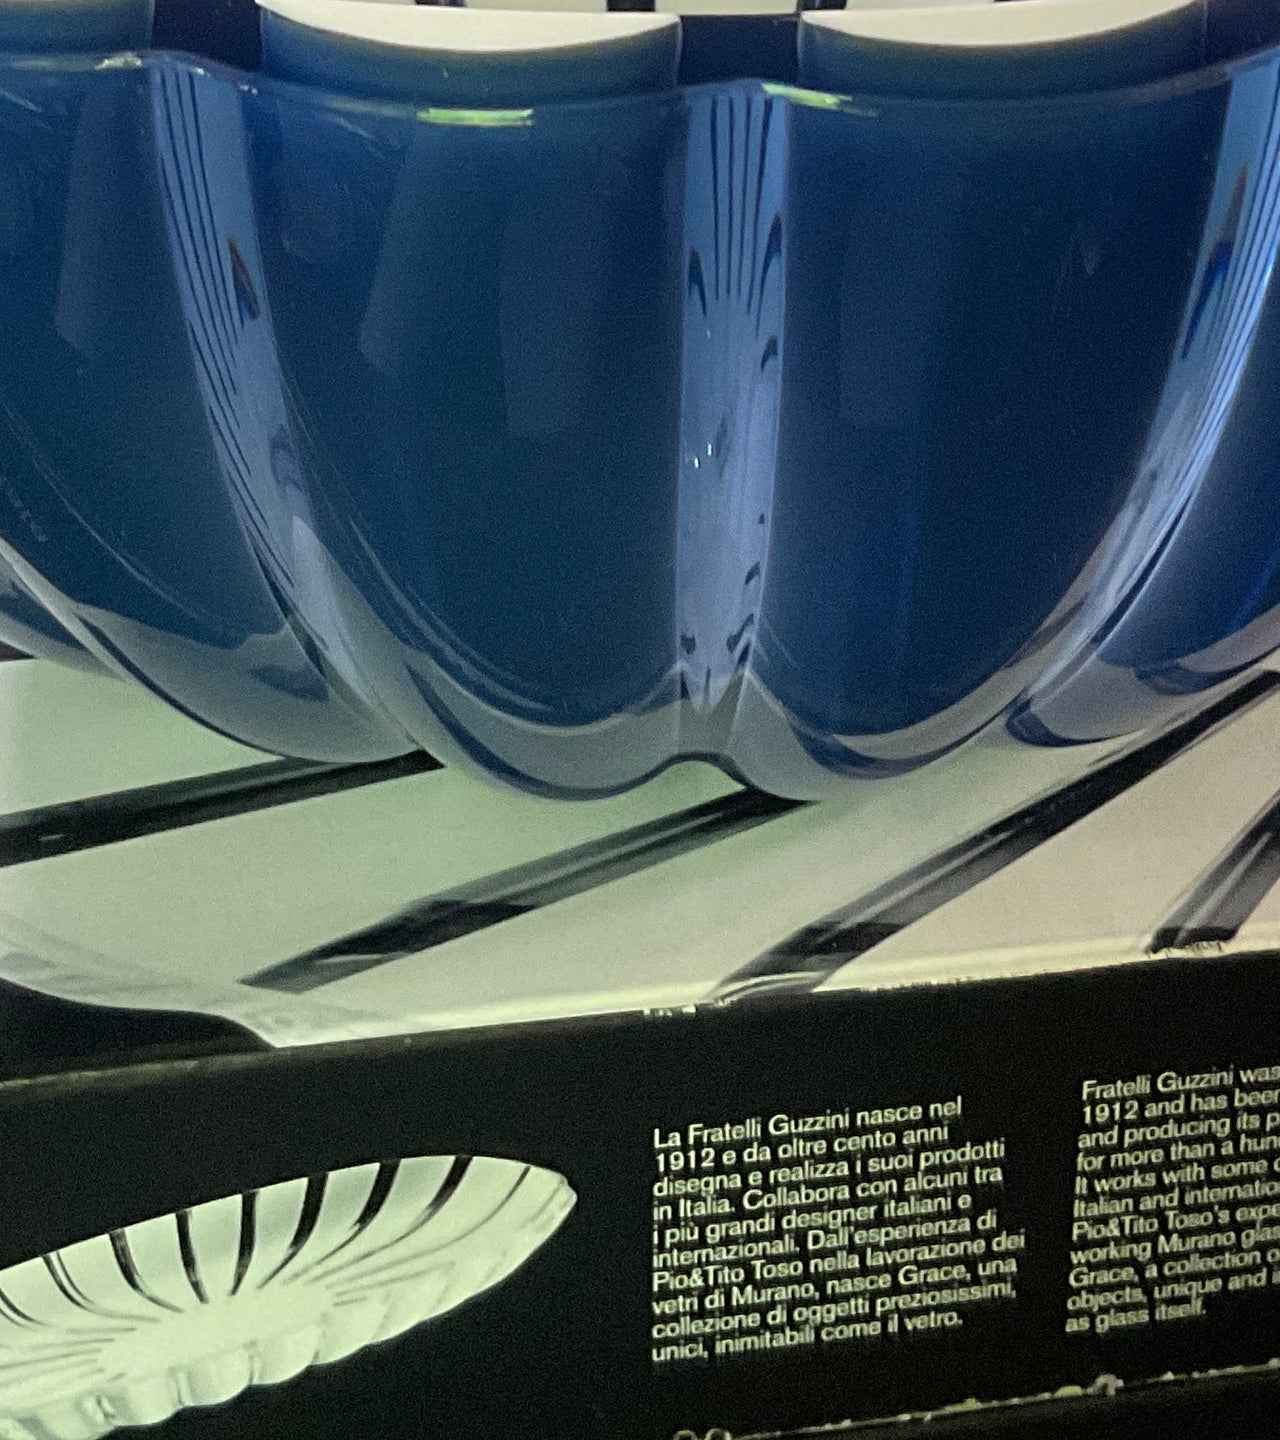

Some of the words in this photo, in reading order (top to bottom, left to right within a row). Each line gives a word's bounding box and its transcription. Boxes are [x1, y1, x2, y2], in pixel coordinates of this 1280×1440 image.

[1082, 1075, 1150, 1100] Fratelli
[1156, 1066, 1233, 1092] Guzzini
[653, 1129, 681, 1149] La
[687, 1118, 761, 1144] Fratelli
[768, 1109, 849, 1135] Guzzini
[856, 1105, 922, 1126] nasce
[929, 1096, 961, 1117] nel
[1083, 1100, 1138, 1123] 1912
[1144, 1094, 1185, 1117] and
[1190, 1093, 1227, 1111] has
[656, 1147, 714, 1172] 1912
[721, 1149, 736, 1165] e
[742, 1142, 771, 1162] da
[777, 1138, 826, 1158] oltre
[833, 1131, 895, 1152] cento
[902, 1121, 948, 1144] anni
[1077, 1125, 1118, 1148] and
[1123, 1117, 1230, 1146] producing
[1236, 1111, 1260, 1129] its
[653, 1173, 741, 1196] disegna
[747, 1170, 762, 1186] e
[769, 1160, 848, 1183] realizza
[855, 1154, 861, 1174] i
[867, 1149, 913, 1172] suoi
[919, 1139, 1004, 1170] prodotti
[1076, 1152, 1103, 1171] for
[1110, 1148, 1164, 1167] more
[1170, 1141, 1214, 1160] than
[1220, 1140, 1233, 1155] a
[652, 1201, 672, 1221] in
[742, 1185, 849, 1209] Collabora
[855, 1179, 897, 1197] con
[903, 1171, 967, 1191] alcuni
[974, 1166, 1002, 1183] tra
[1074, 1175, 1087, 1195] It
[1094, 1169, 1156, 1192] works
[1162, 1162, 1205, 1184] with
[1211, 1159, 1267, 1178] some
[652, 1224, 658, 1244] i
[664, 1221, 699, 1246] più
[705, 1211, 775, 1241] grandi
[781, 1205, 875, 1229] designer
[883, 1192, 951, 1217] italiani
[957, 1193, 971, 1208] e
[1073, 1196, 1133, 1217] Italian
[1139, 1186, 1179, 1210] and
[652, 1234, 798, 1267] internazionali.
[807, 1218, 970, 1249] Dall'esperienza
[976, 1209, 996, 1230] di
[1072, 1215, 1158, 1240] Pio&Tito
[652, 1265, 744, 1291] Pio&Tito
[752, 1259, 803, 1279] Toso
[809, 1250, 859, 1272] nella
[865, 1239, 985, 1265] lavorazione
[991, 1229, 1024, 1251] dei
[1070, 1241, 1151, 1268] working
[1157, 1231, 1235, 1253] Murano
[1144, 1263, 1158, 1278] a
[1163, 1246, 1260, 1275] collection
[652, 1291, 698, 1315] vetri
[704, 1288, 725, 1309] di
[826, 1273, 891, 1294] nasce
[977, 1258, 1017, 1275] una
[1153, 1278, 1222, 1299] unique
[1227, 1267, 1267, 1290] and
[652, 1312, 760, 1338] collezione
[766, 1304, 787, 1325] di
[793, 1296, 869, 1325] oggetti
[875, 1282, 1015, 1315] preziosissimi,
[1065, 1316, 1090, 1332] as
[1095, 1308, 1148, 1332] glass
[651, 1338, 707, 1361] unici,
[715, 1324, 814, 1353] inimitabili
[820, 1321, 881, 1341] come
[887, 1313, 898, 1332] il
[904, 1311, 962, 1330] vetro.
